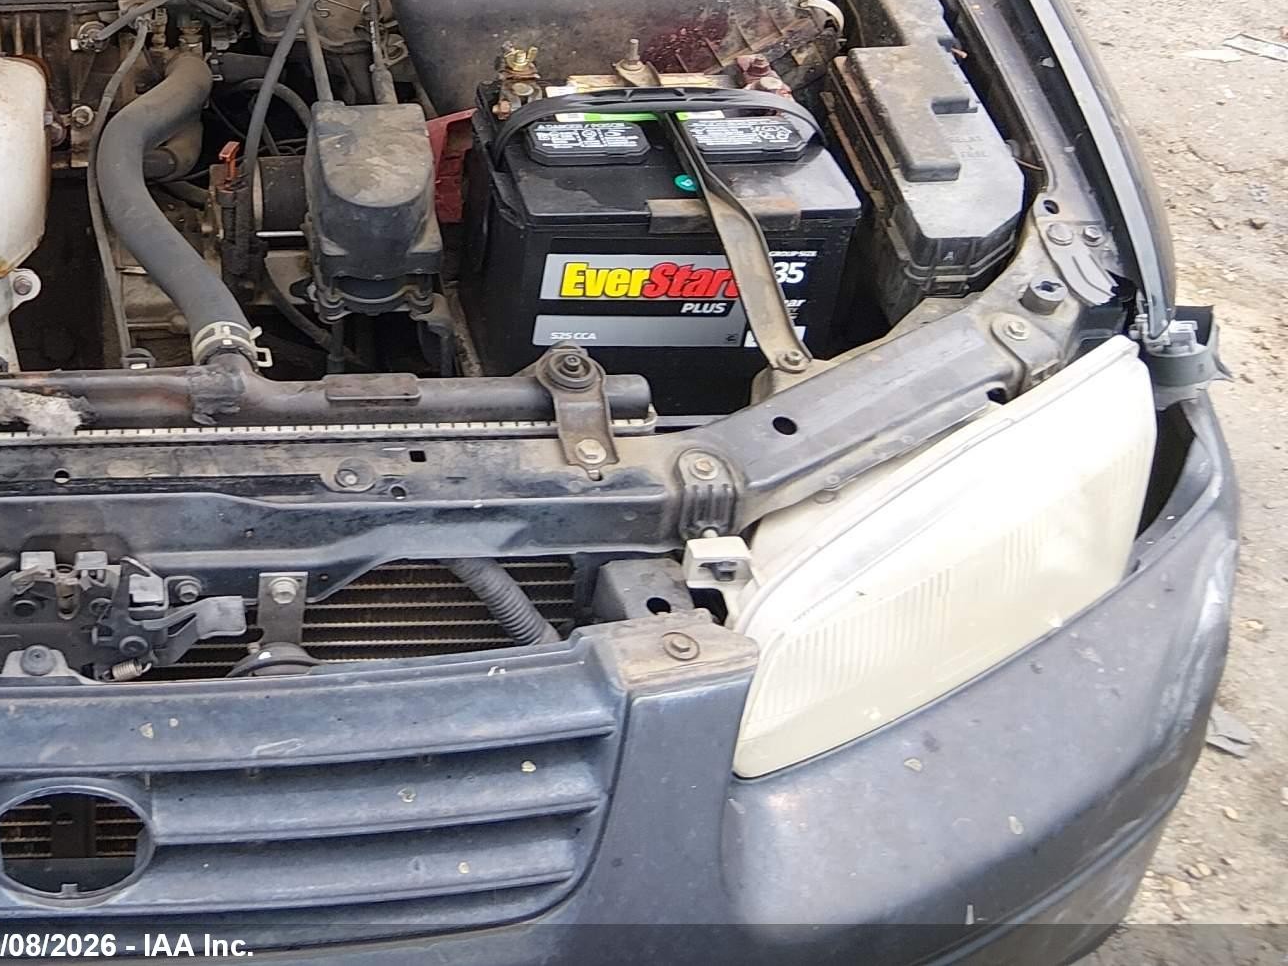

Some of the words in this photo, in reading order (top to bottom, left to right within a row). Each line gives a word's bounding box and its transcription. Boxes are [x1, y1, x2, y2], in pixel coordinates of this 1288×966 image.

[773, 261, 807, 284] 35
[680, 302, 728, 314] PLUS
[550, 332, 573, 340] 525
[573, 332, 597, 340] CCA
